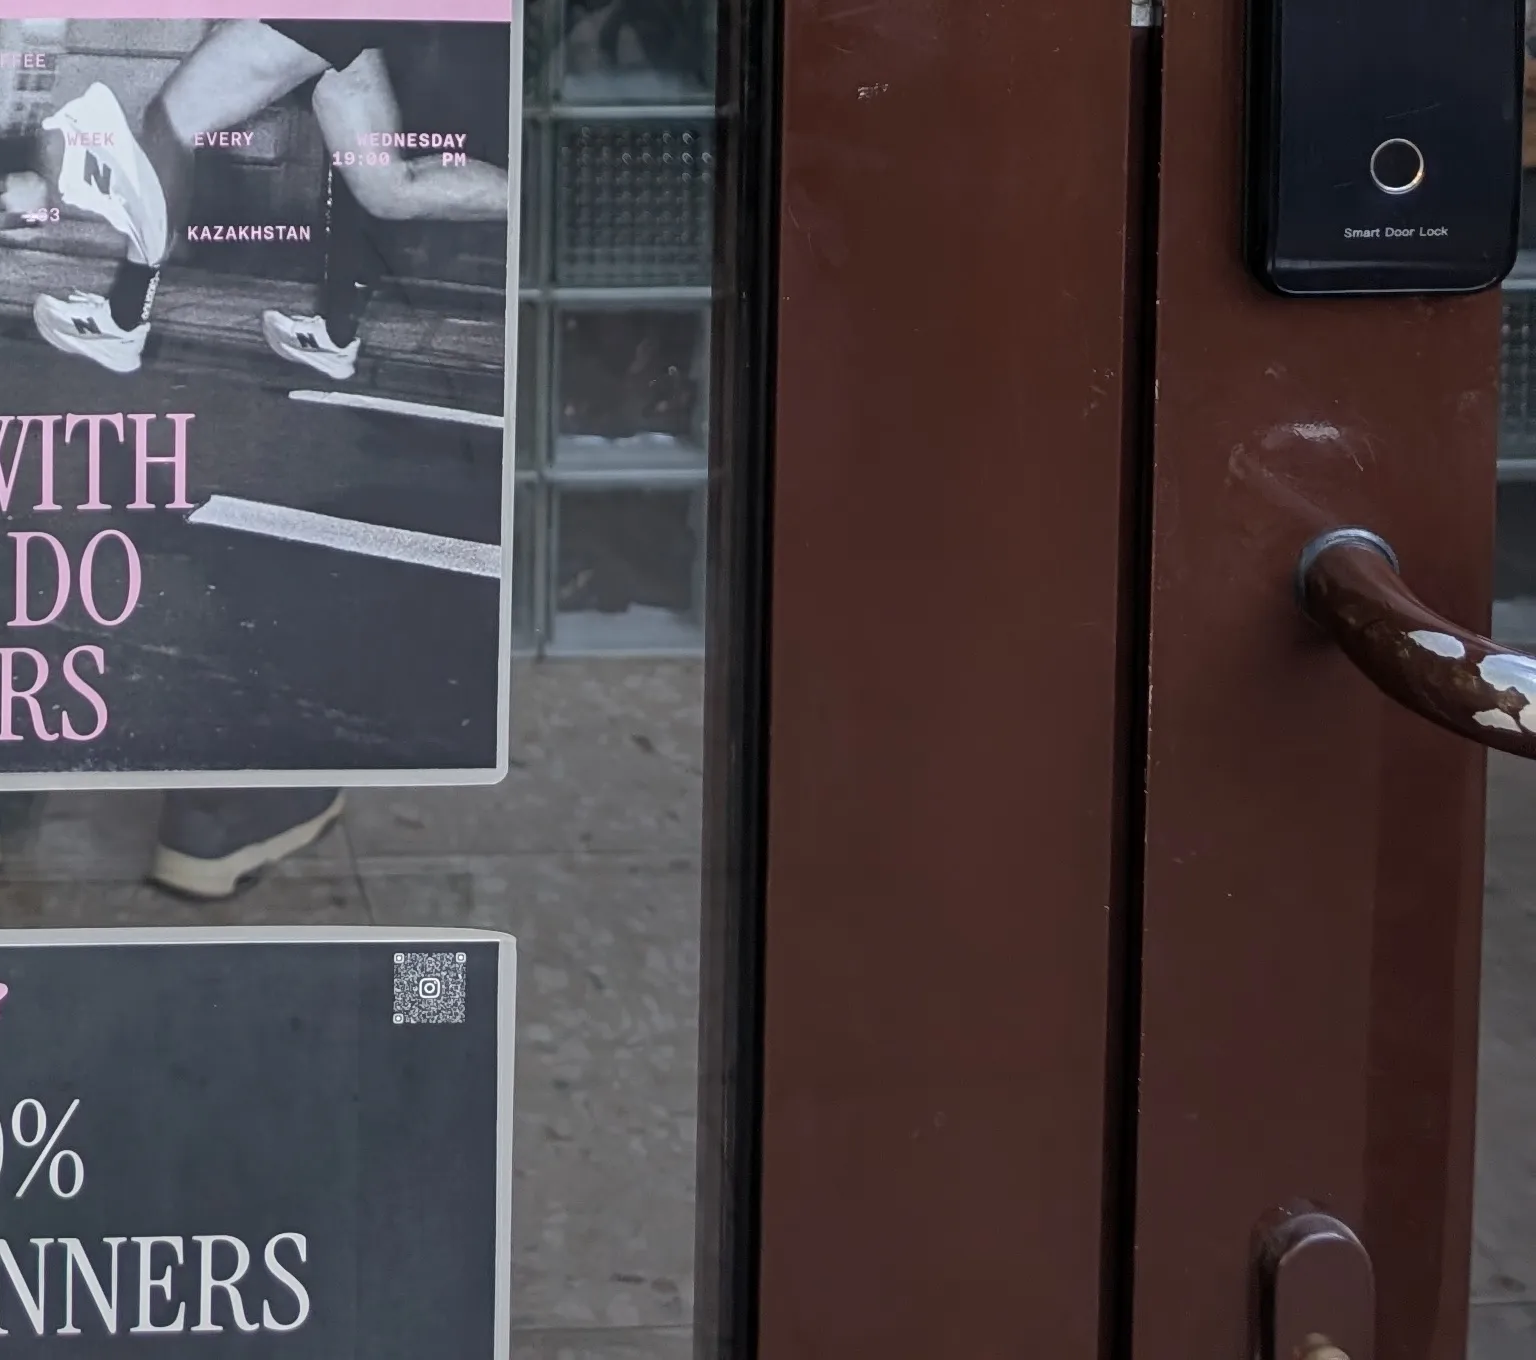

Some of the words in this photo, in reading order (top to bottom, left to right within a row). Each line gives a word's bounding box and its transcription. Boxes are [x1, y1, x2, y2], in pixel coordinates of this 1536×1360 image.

[67, 132, 115, 147] WEEK
[194, 131, 254, 147] EVERY
[356, 132, 467, 148] WEDNESDAY
[332, 151, 390, 166] 19:00
[441, 152, 466, 167] PM
[83, 149, 112, 195] N
[187, 225, 311, 241] KAZAKHSTAN
[1344, 227, 1381, 238] Smart
[1384, 227, 1416, 238] Door
[1419, 226, 1449, 237] Lock
[71, 316, 102, 335] N
[295, 332, 319, 348] N
[6, 529, 142, 627] DO
